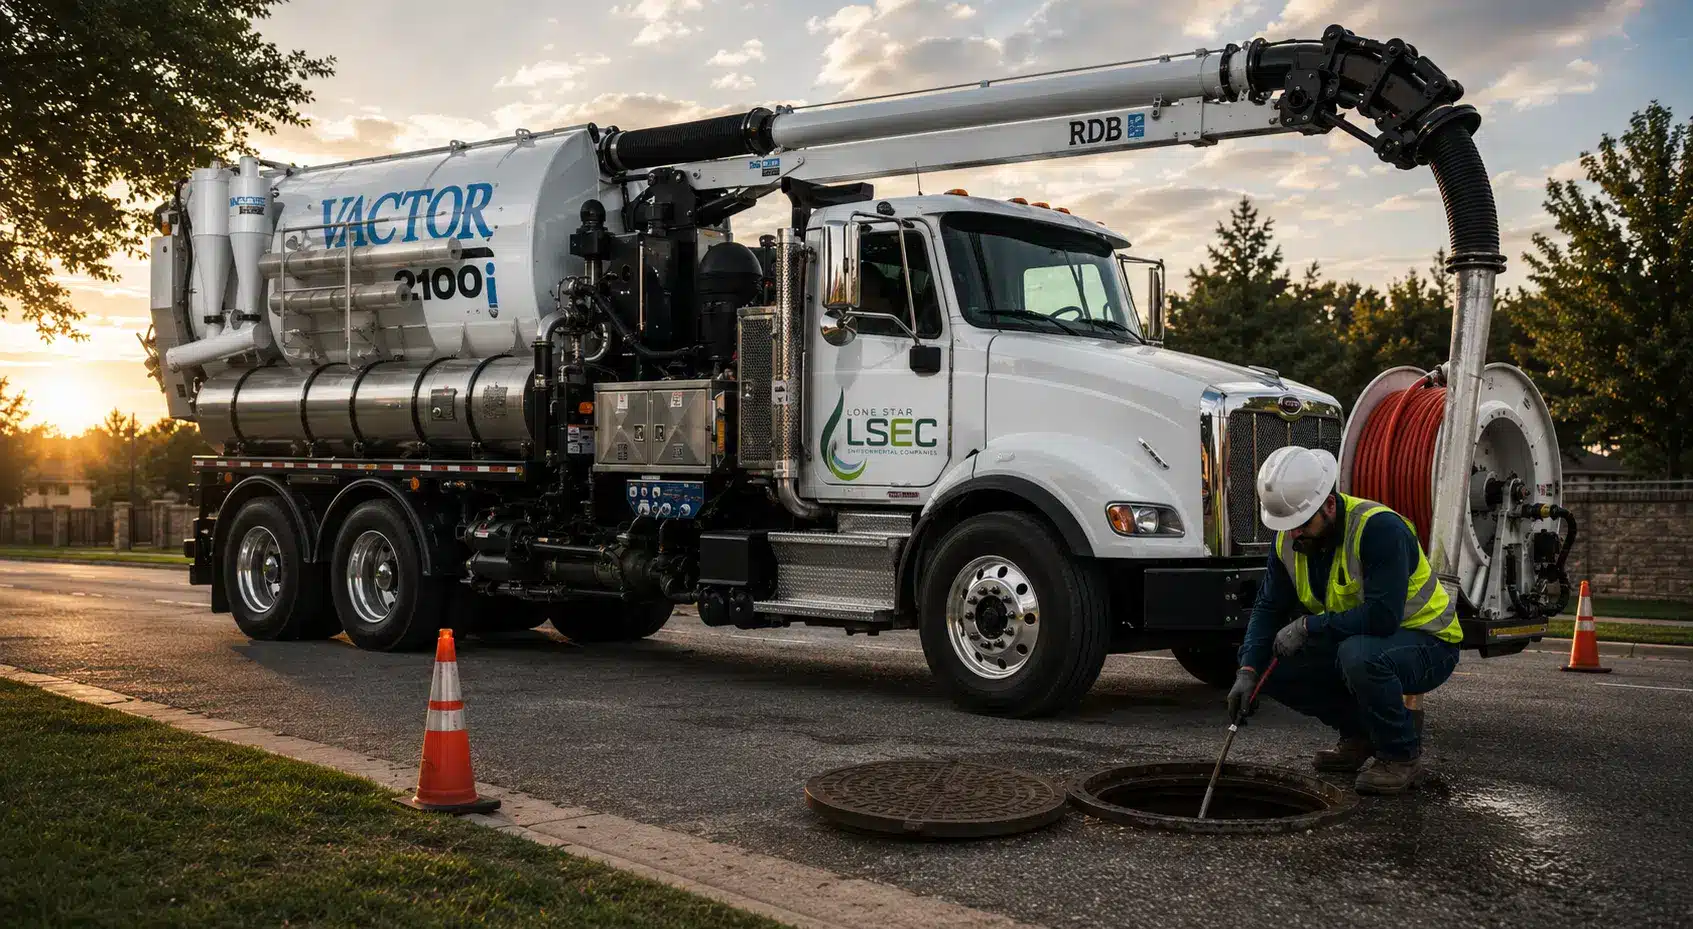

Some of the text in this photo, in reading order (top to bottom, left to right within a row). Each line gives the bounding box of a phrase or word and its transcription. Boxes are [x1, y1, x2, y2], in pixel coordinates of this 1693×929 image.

[1069, 117, 1122, 145] RDB
[322, 183, 493, 249] VACTOR
[847, 408, 913, 416] LONE STAR
[847, 418, 937, 447] LSEC
